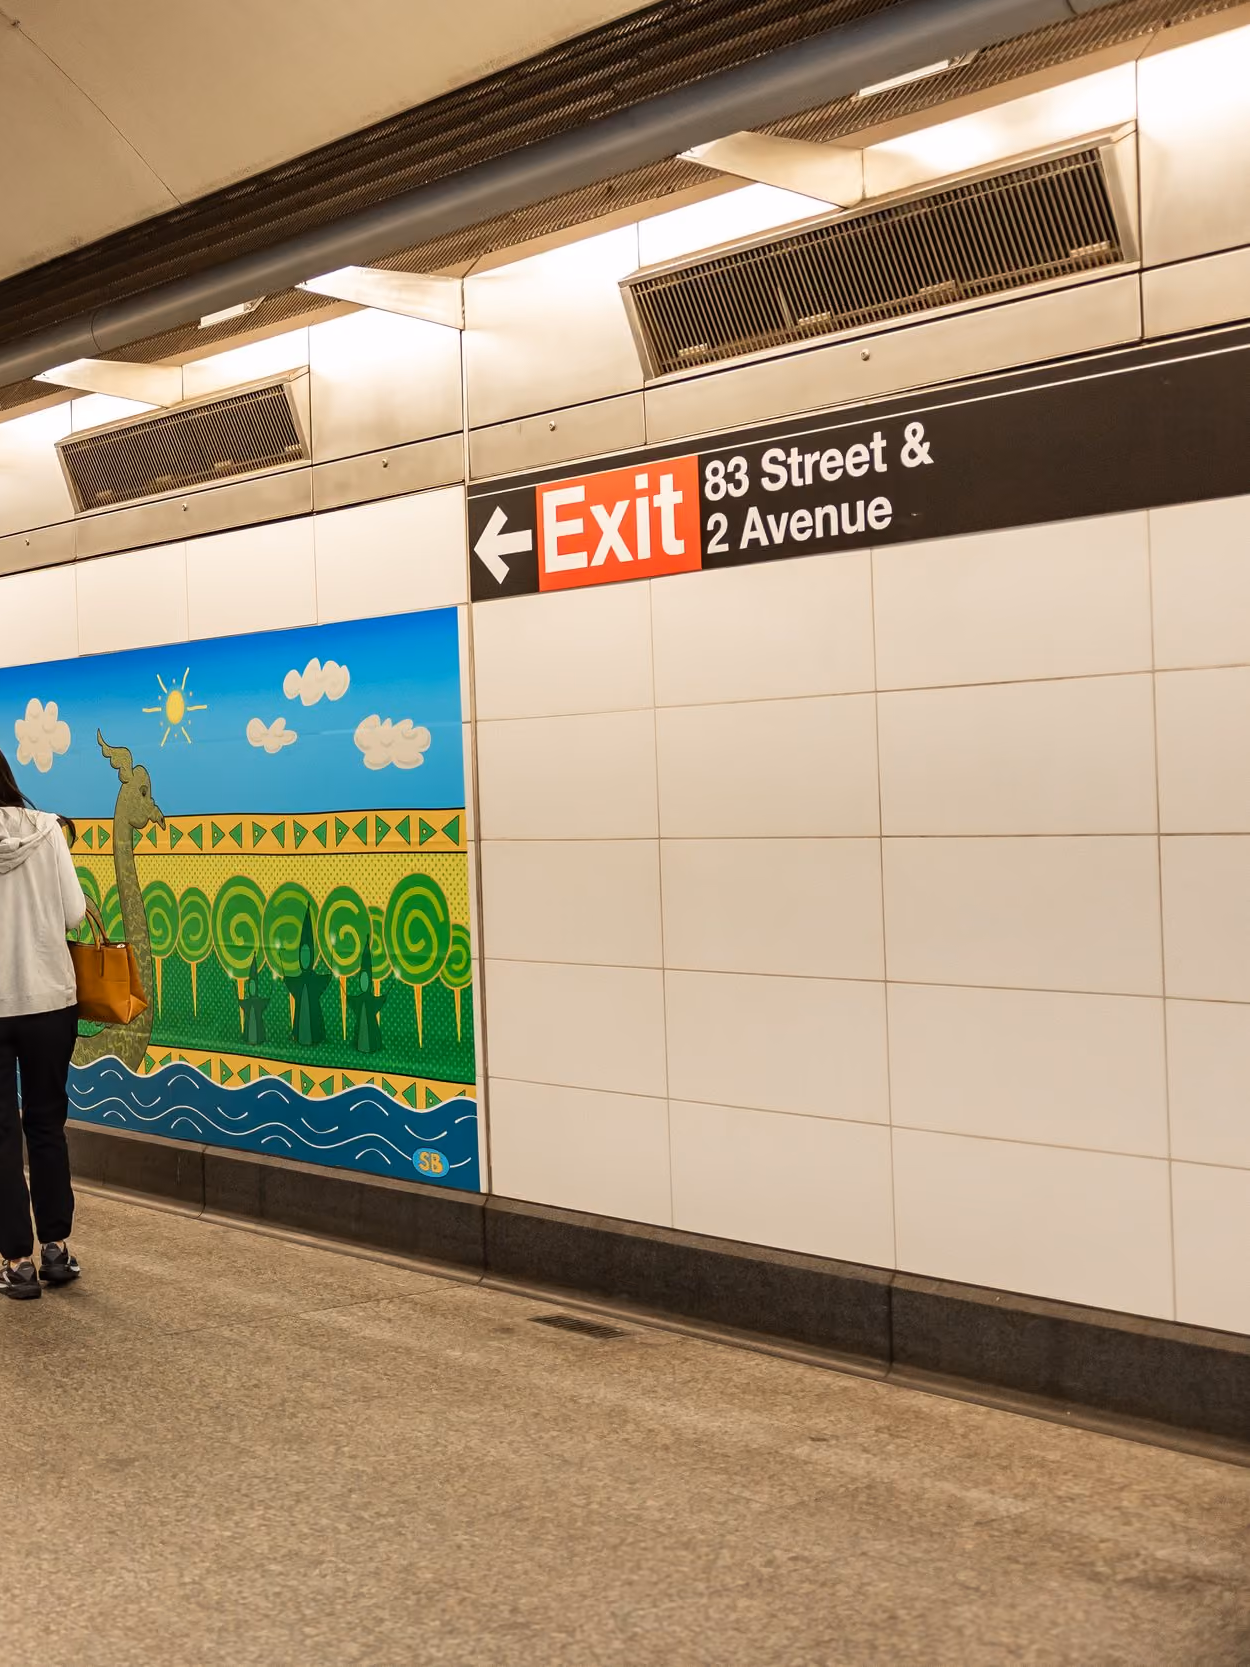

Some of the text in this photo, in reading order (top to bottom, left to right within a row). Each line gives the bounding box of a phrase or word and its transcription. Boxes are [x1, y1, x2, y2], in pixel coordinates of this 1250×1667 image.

[703, 421, 935, 502] 83 Street &
[542, 473, 686, 574] Exit
[706, 496, 893, 555] 2 Avenue
[418, 1151, 443, 1173] SB
